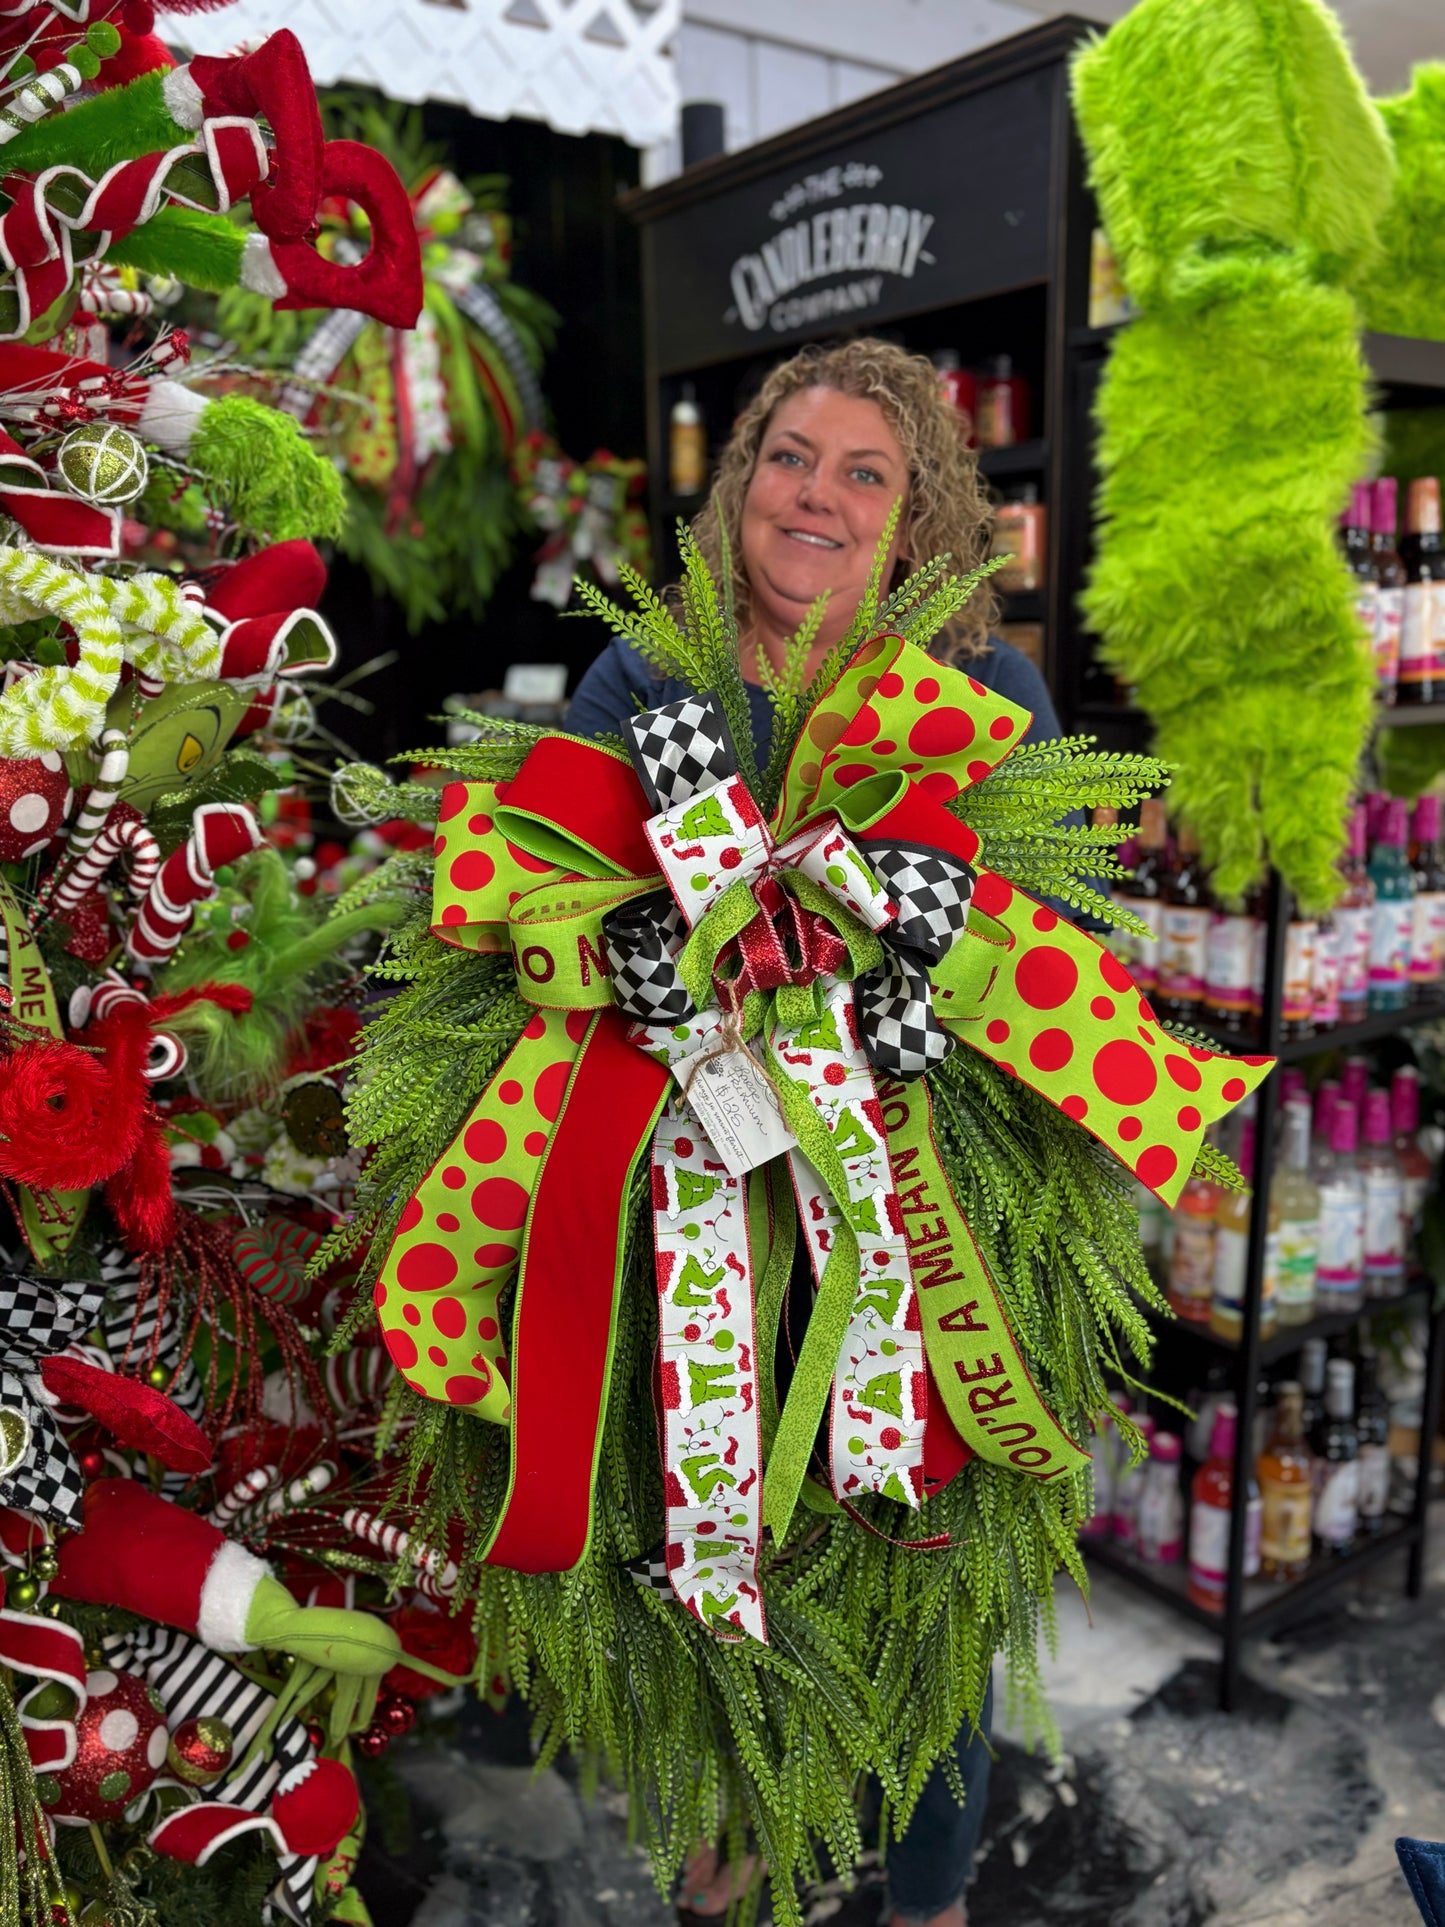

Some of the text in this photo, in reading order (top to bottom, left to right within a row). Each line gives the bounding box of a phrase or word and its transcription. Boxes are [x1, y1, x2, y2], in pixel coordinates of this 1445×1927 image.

[769, 275, 883, 332] COMPANY
[14, 926, 33, 950] A
[714, 1083, 745, 1128] $125
[892, 1147, 965, 1290] MEAN
[937, 1300, 989, 1332] A
